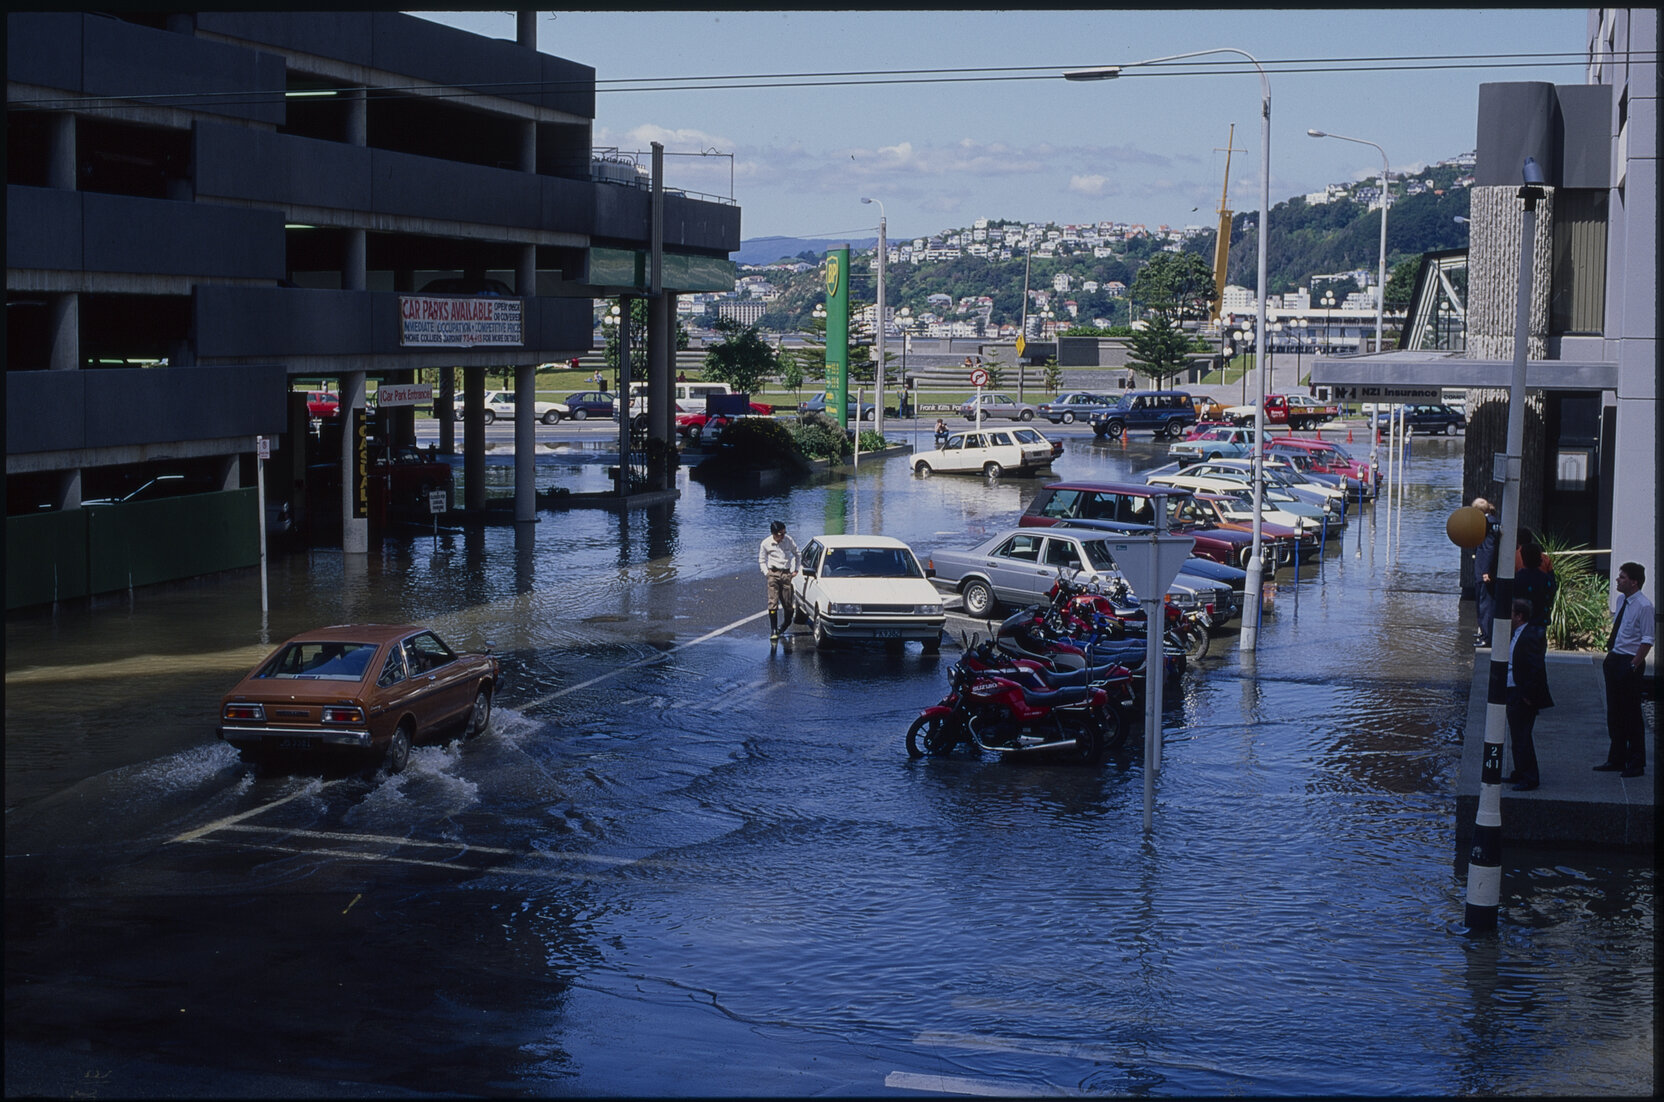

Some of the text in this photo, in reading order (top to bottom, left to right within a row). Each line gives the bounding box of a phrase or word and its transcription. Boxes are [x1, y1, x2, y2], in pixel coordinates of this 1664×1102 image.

[828, 263, 837, 284] BP
[402, 299, 493, 321] CAR PARKS AVAILABLE
[493, 312, 501, 321] OR
[404, 320, 435, 333] MMEDIATE
[507, 323, 521, 334] PRICE
[482, 334, 492, 343] FOR
[382, 388, 430, 402] Car Park Entrance
[1361, 387, 1438, 398] NZI Insurance
[1490, 746, 1499, 757] 2
